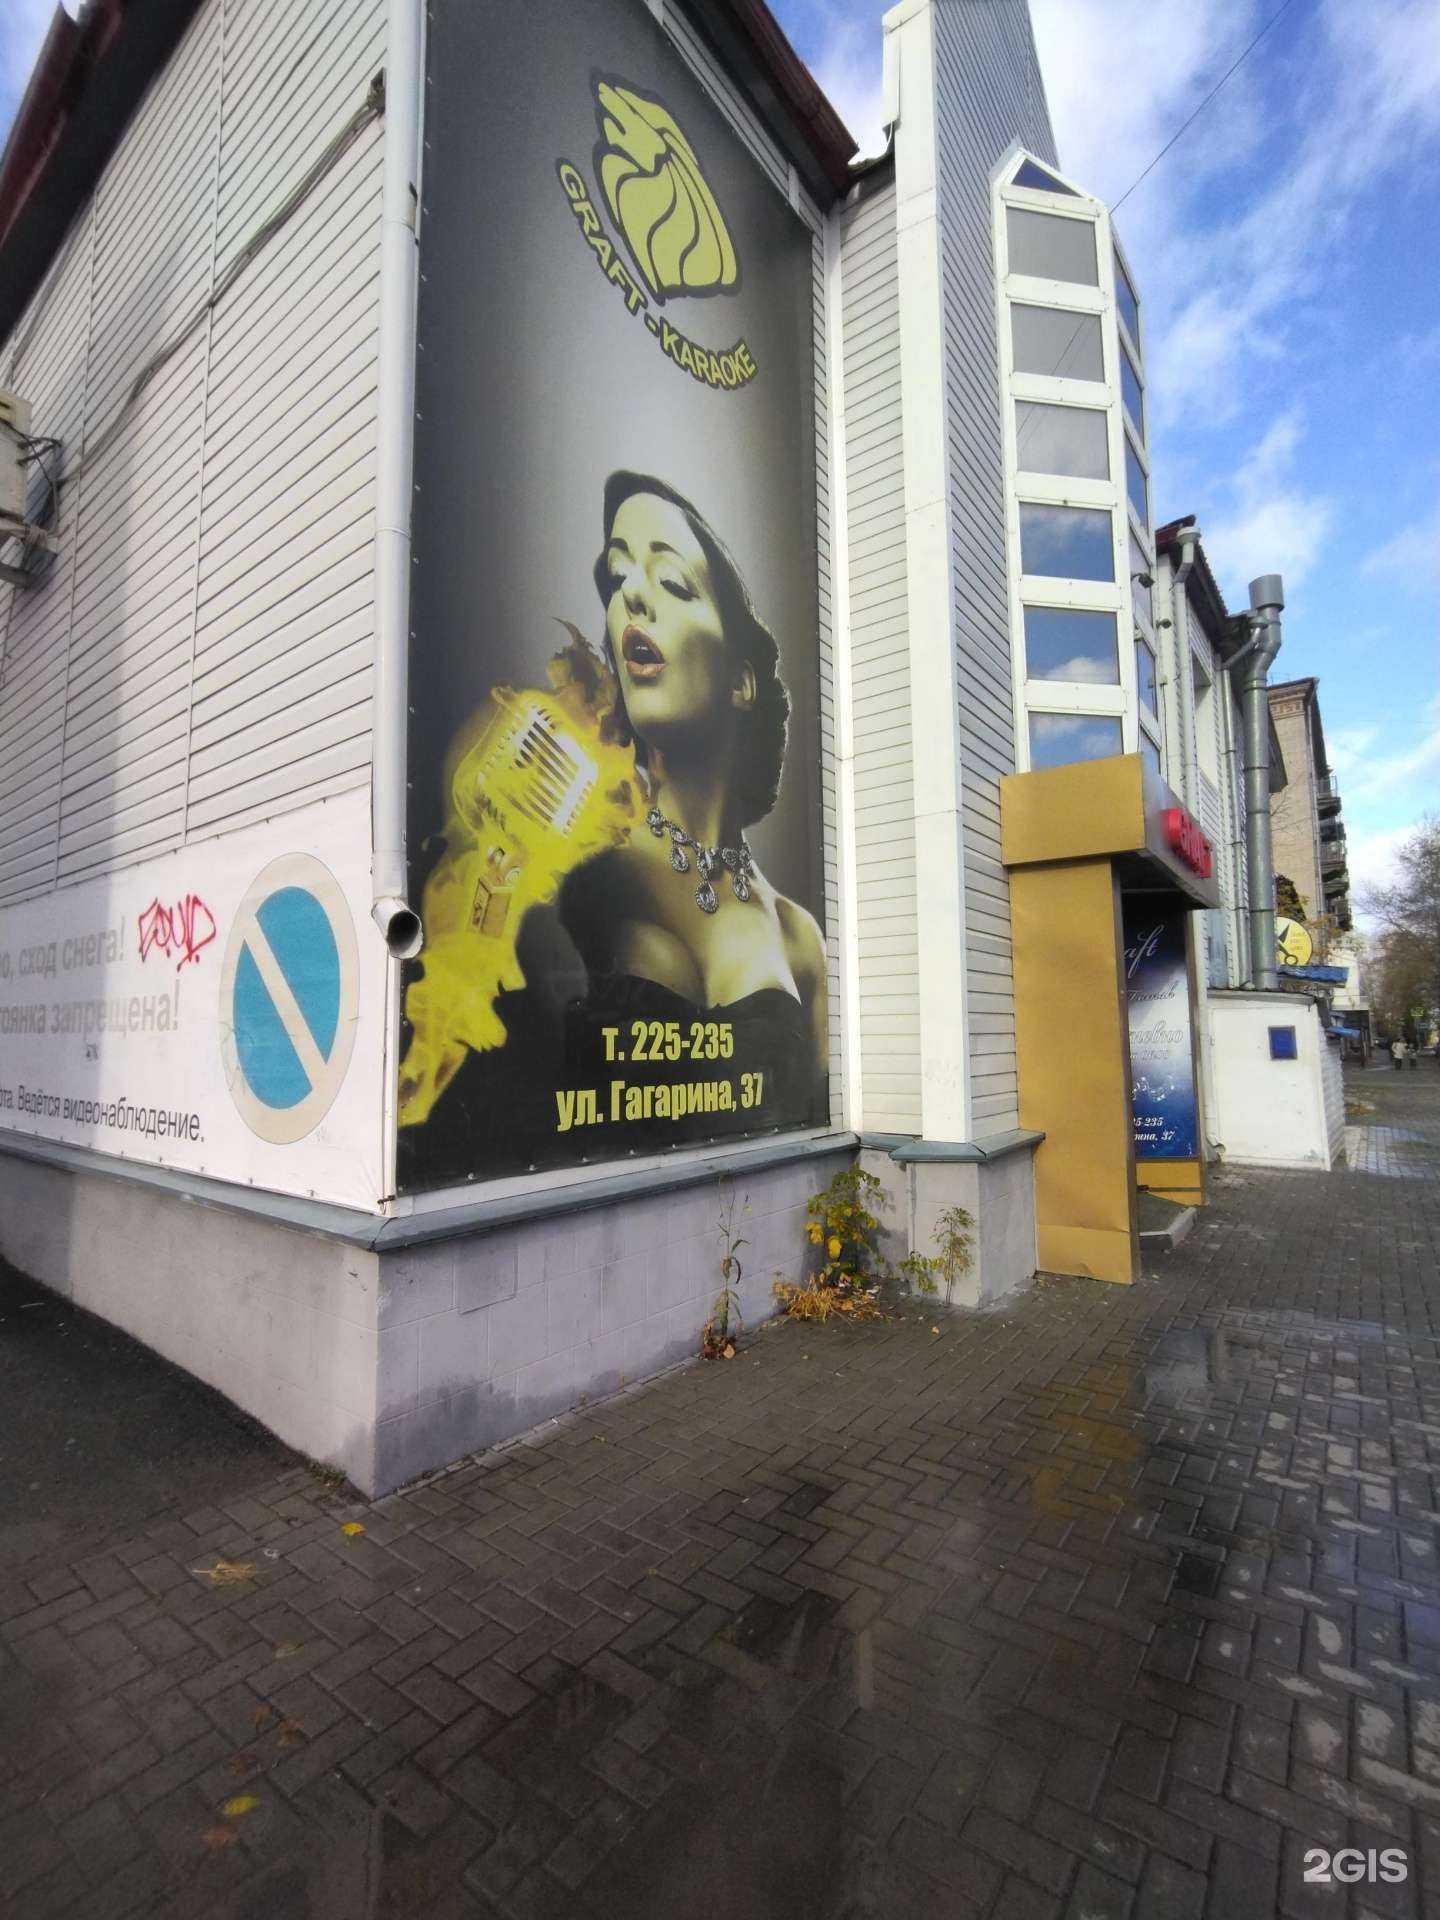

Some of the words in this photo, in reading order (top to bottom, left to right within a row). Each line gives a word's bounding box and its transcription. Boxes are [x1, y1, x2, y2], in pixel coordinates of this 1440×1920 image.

[18, 942, 57, 979] сход
[62, 914, 126, 971] снега!
[51, 978, 181, 1041] запрещена!
[631, 1020, 734, 1061] 225-235
[18, 1085, 60, 1121] Ведётся
[63, 1096, 205, 1144] видеонаблюдение.
[556, 1089, 604, 1132] ул.
[610, 1079, 737, 1121] Гагарина,
[741, 1072, 764, 1108] 37
